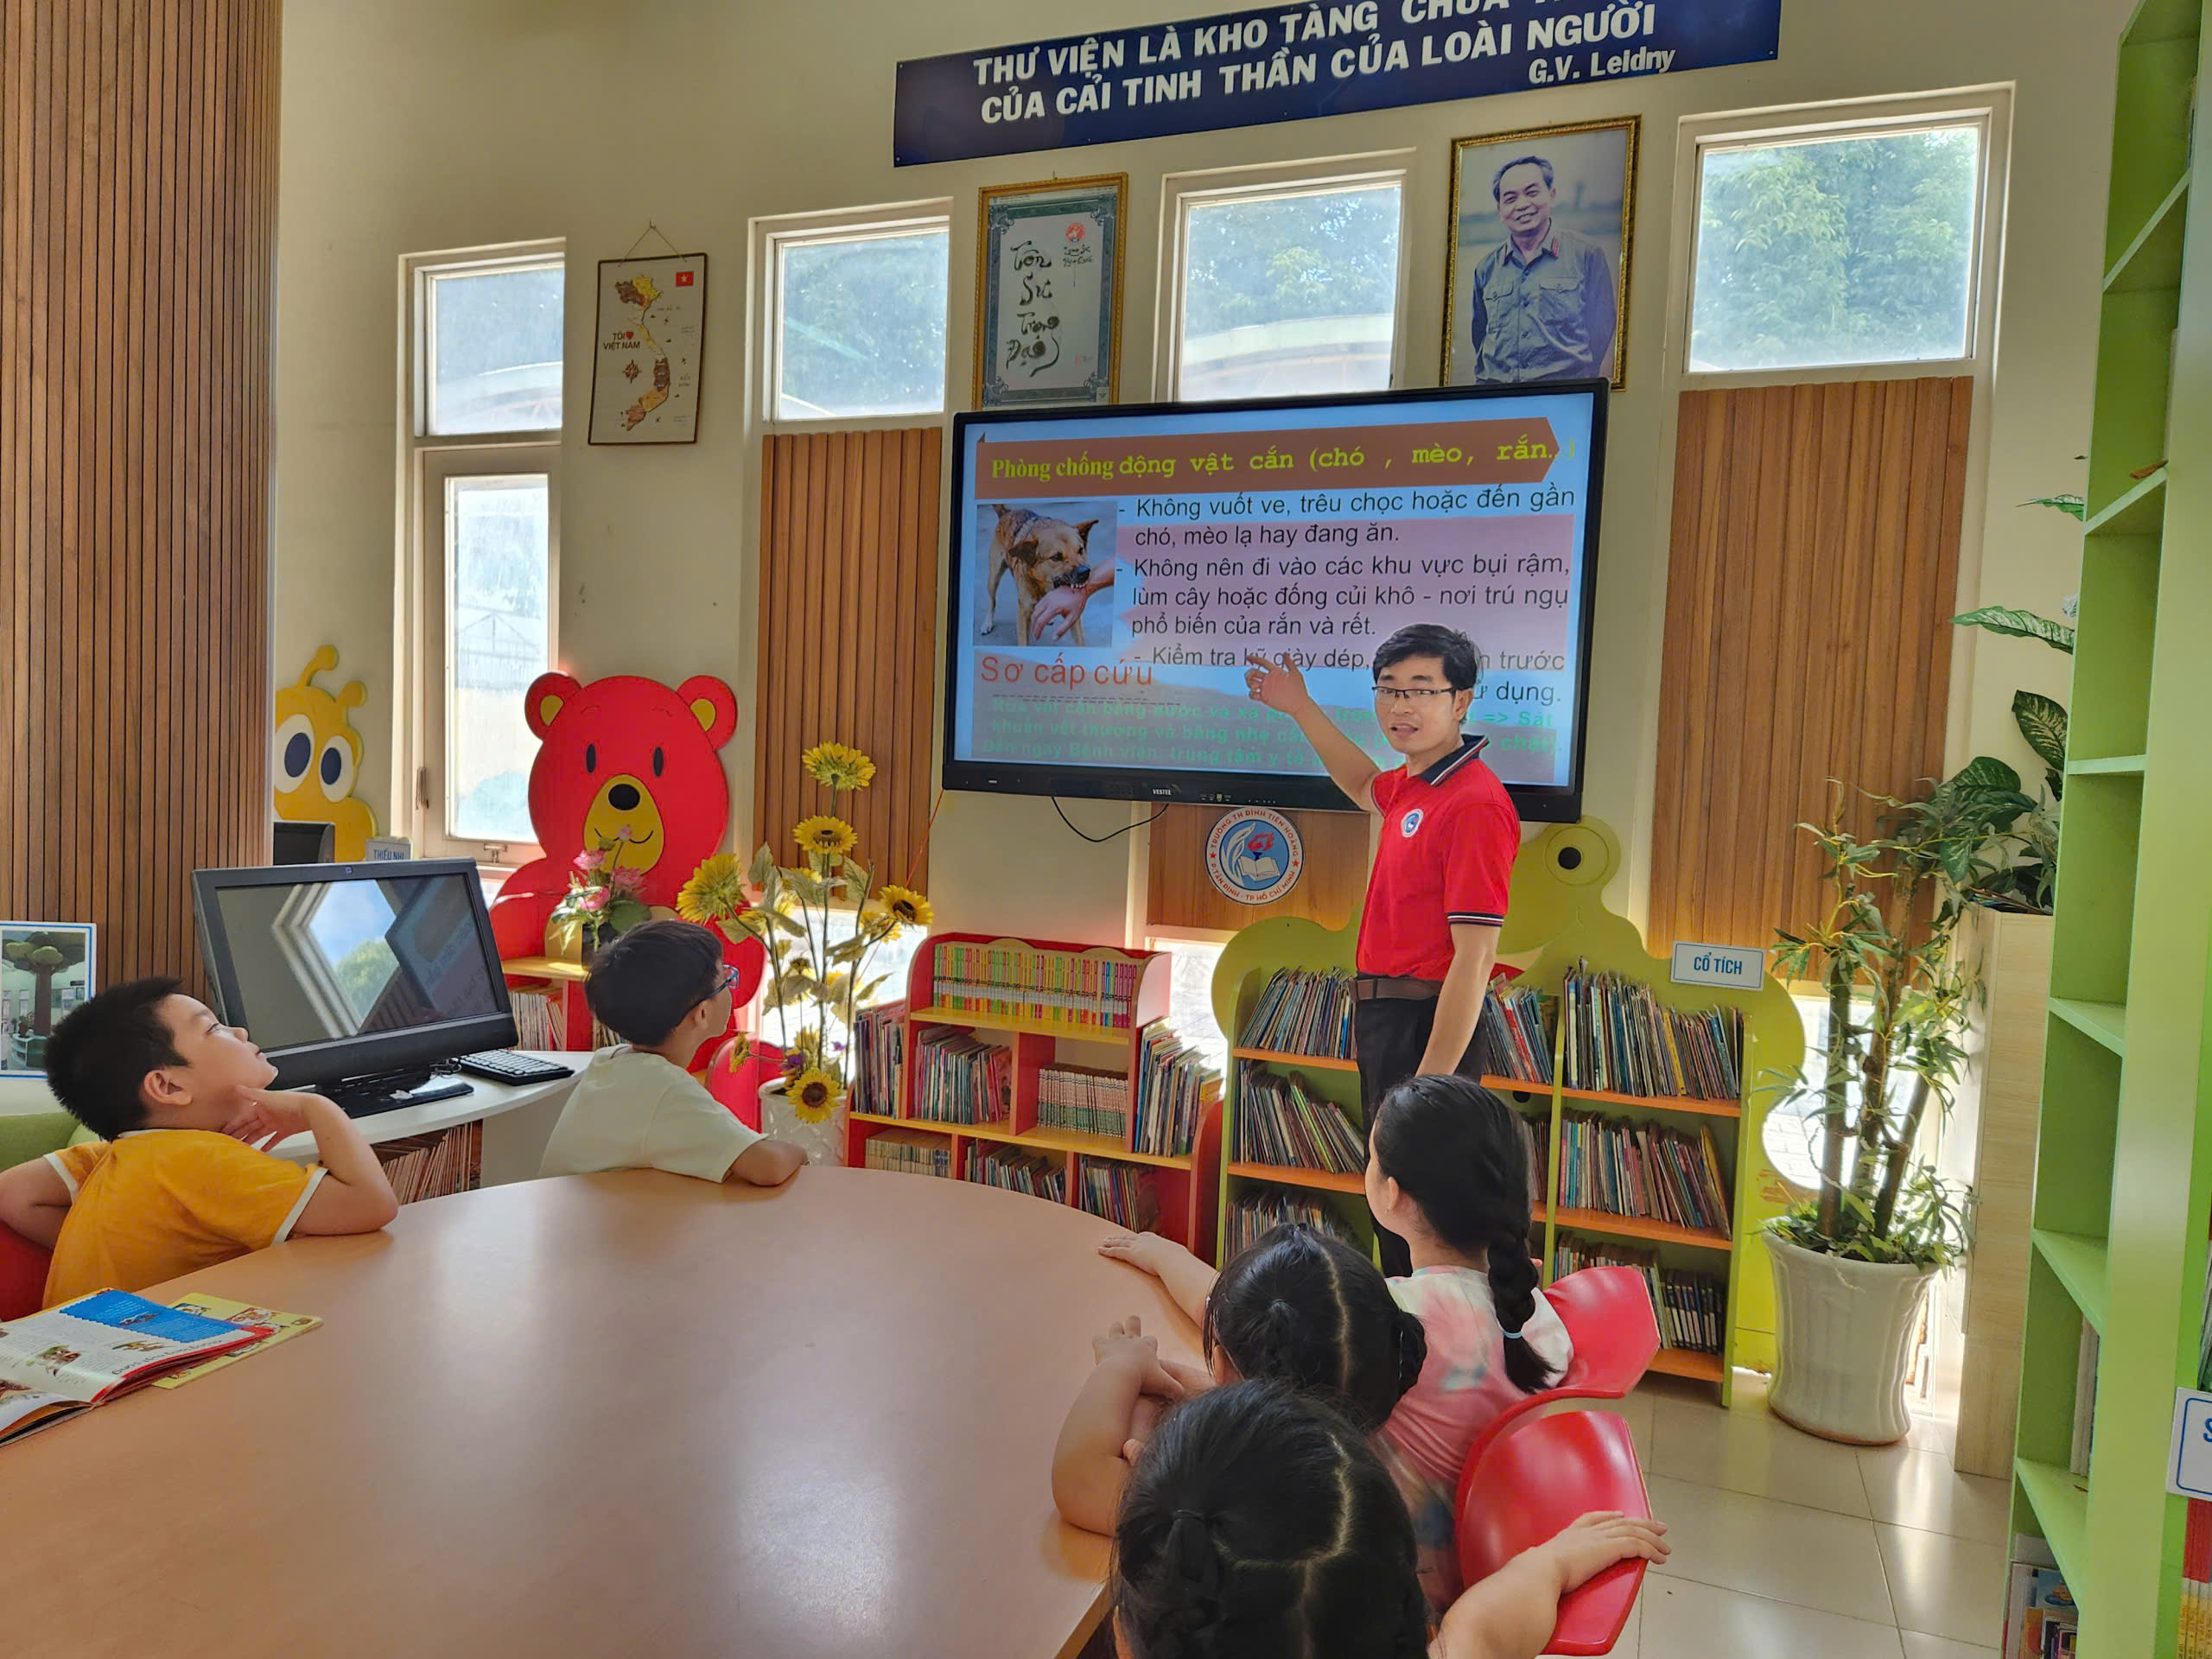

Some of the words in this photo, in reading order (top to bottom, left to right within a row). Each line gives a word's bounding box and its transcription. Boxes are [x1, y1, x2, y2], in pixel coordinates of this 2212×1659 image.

[973, 45, 1039, 86] THƯ
[1048, 38, 1124, 78] VIỆN
[1139, 25, 1181, 64] LÀ
[1194, 19, 1268, 56] KHO
[1280, 2, 1378, 43] TÀNG
[982, 86, 1046, 124] CỦA
[1056, 73, 1112, 115] CẢI
[1122, 69, 1202, 106] TINH
[1218, 46, 1316, 94] THẦN
[1331, 33, 1409, 79] CỦA
[1421, 20, 1511, 67] LOÀI
[1527, 0, 1656, 51] NGƯỜI
[1528, 54, 1581, 85] G.V.
[1591, 46, 1676, 77] Leidny
[991, 458, 1051, 481] Phòng
[1057, 451, 1114, 480] chống
[1120, 455, 1175, 478] động
[1190, 453, 1235, 475] vật
[1250, 445, 1294, 469] cắn
[1309, 446, 1365, 472] (chó
[1411, 442, 1473, 466] mèo,
[1136, 497, 1201, 520] Không
[1210, 492, 1253, 516] vuốt
[1261, 499, 1291, 517] ve,
[1300, 493, 1341, 513] trêu
[1351, 493, 1403, 515] chọc
[1412, 489, 1467, 513] hoặc
[1477, 483, 1520, 508] đến
[1530, 481, 1574, 512] gần
[1135, 527, 1176, 548] chó,
[1184, 526, 1228, 546] mèo
[1235, 525, 1252, 544] lạ
[1260, 525, 1297, 548] hay
[1304, 524, 1358, 546] đang
[1366, 522, 1400, 543] ăn.
[1135, 557, 1198, 582] Không
[1206, 557, 1243, 576] nên
[1252, 557, 1270, 575] đi
[1279, 556, 1317, 575] vào
[1325, 556, 1363, 575] các
[1371, 555, 1412, 575] khu
[1421, 558, 1464, 578] vực
[1473, 553, 1507, 577] bụi
[1517, 553, 1570, 576] rậm,
[1132, 587, 1167, 607] lùm
[1174, 587, 1209, 609] cây
[1217, 587, 1268, 608] hoặc
[1274, 584, 1328, 609] đống
[1335, 585, 1367, 605] củi
[1375, 585, 1415, 605] khô
[1440, 585, 1476, 605] nơi
[1484, 584, 1515, 604] trú
[1524, 588, 1569, 609] ngụ
[1132, 612, 1168, 638] phổ
[1175, 613, 1216, 634] biến
[1224, 614, 1261, 635] của
[1268, 613, 1301, 635] rắn
[1309, 615, 1333, 635] và
[981, 656, 1022, 683] Sơ
[1034, 652, 1085, 690] cấp
[1094, 658, 1153, 685] cứu
[1153, 644, 1203, 665] Kiểm
[1210, 649, 1236, 666] tra
[1324, 648, 1370, 671] dép,
[1500, 650, 1565, 671] trước
[1497, 681, 1561, 706] dụng.
[1336, 708, 1376, 722] tron
[1694, 951, 1712, 971] CỔ
[1713, 956, 1743, 975] TÍCH
